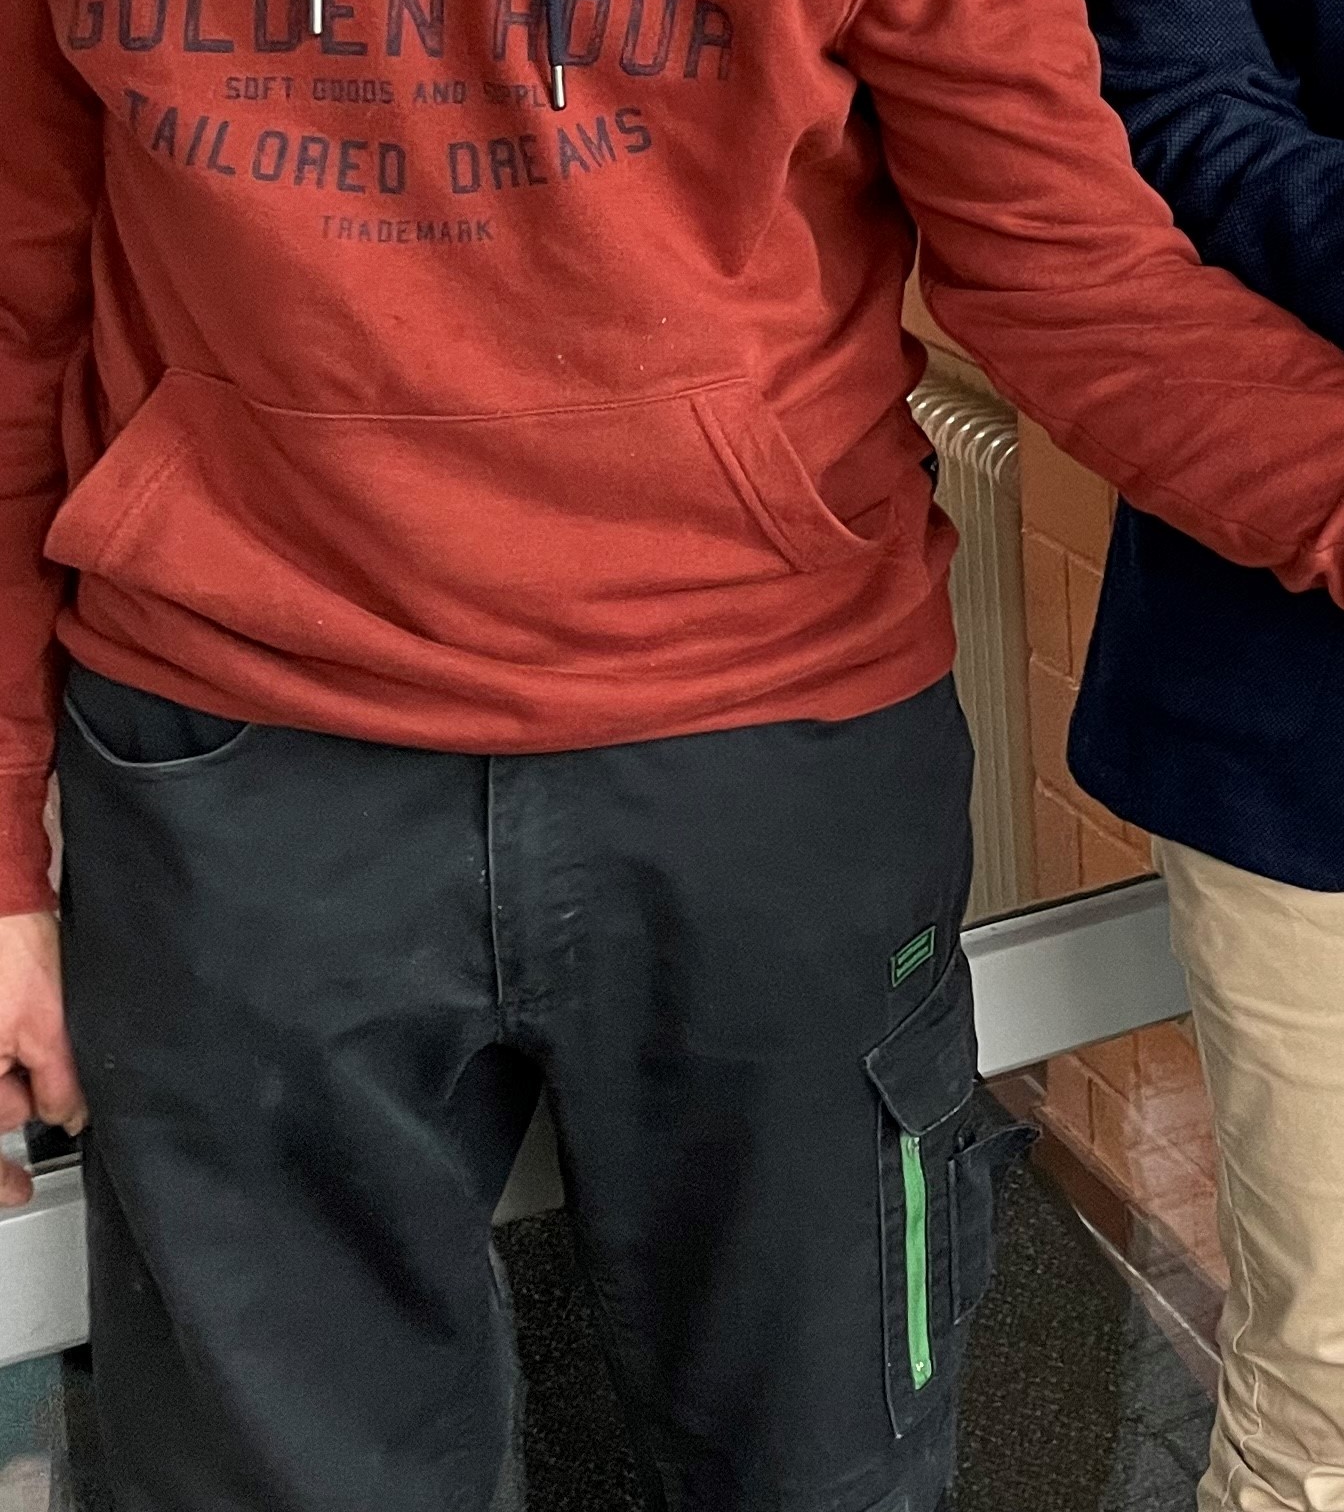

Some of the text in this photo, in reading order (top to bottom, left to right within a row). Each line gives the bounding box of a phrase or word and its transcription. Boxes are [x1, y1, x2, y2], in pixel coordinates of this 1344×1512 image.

[224, 76, 294, 102] SOFT
[312, 76, 395, 105] GOODS
[412, 78, 467, 105] AND
[122, 89, 655, 196] TAILORED DREAMS
[318, 213, 495, 244] TRADEMARK
